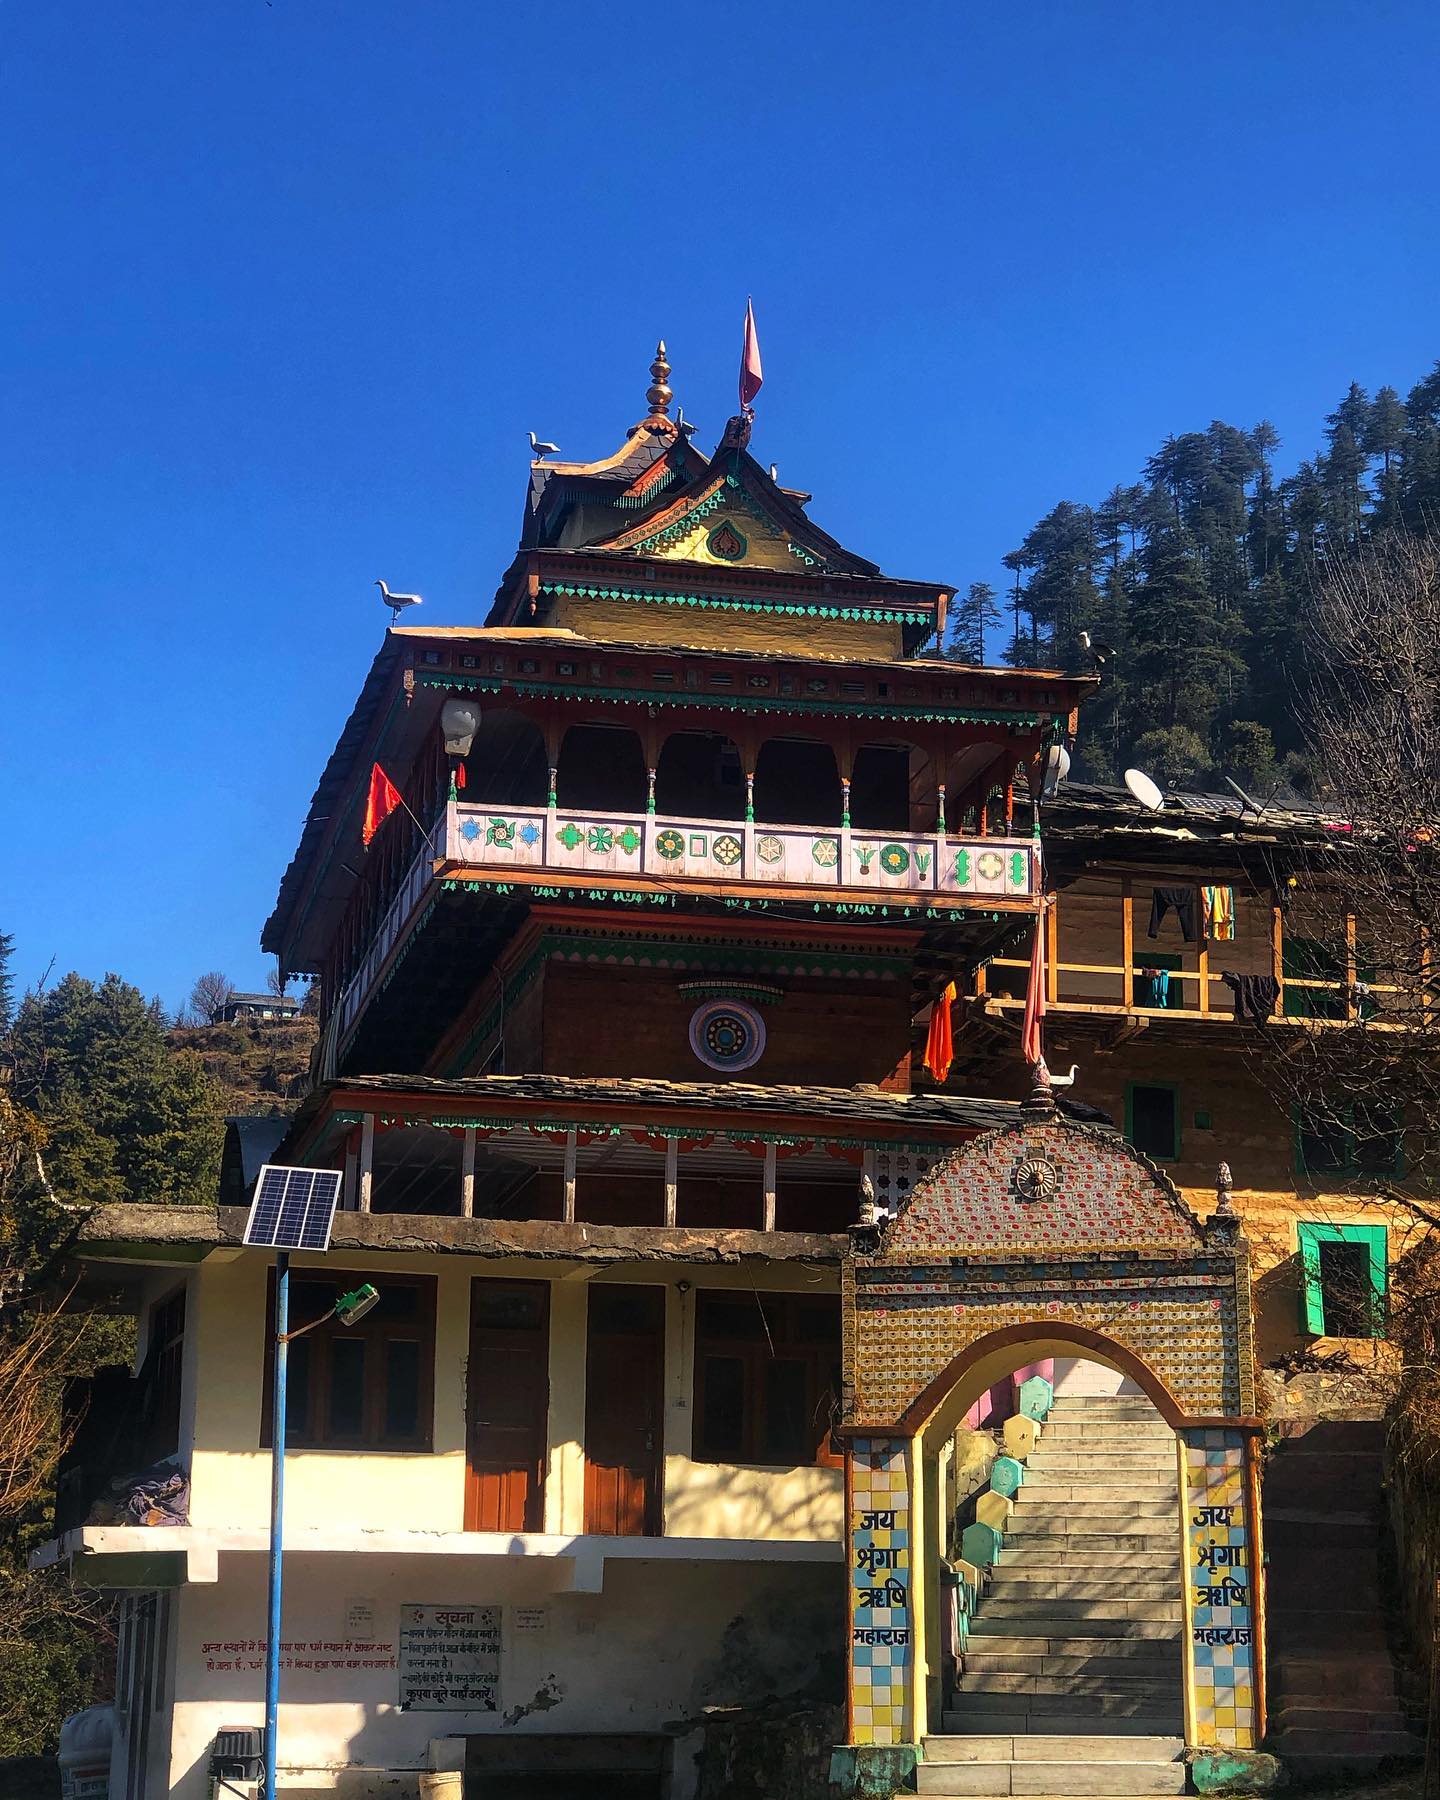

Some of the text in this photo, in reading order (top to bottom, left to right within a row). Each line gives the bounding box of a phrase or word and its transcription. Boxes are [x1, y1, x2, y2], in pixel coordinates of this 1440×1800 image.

[860, 1510, 898, 1530] जय
[1193, 1506, 1234, 1527] जय
[858, 1577, 906, 1608] ऋषि
[1197, 1576, 1247, 1606] ऋषि
[435, 1612, 475, 1630] सूचना
[202, 1643, 222, 1653] अन्य
[224, 1640, 247, 1653] स्थानों
[854, 1629, 910, 1646] महाराज
[1194, 1628, 1252, 1646] महाराज
[432, 1685, 448, 1704] जूते
